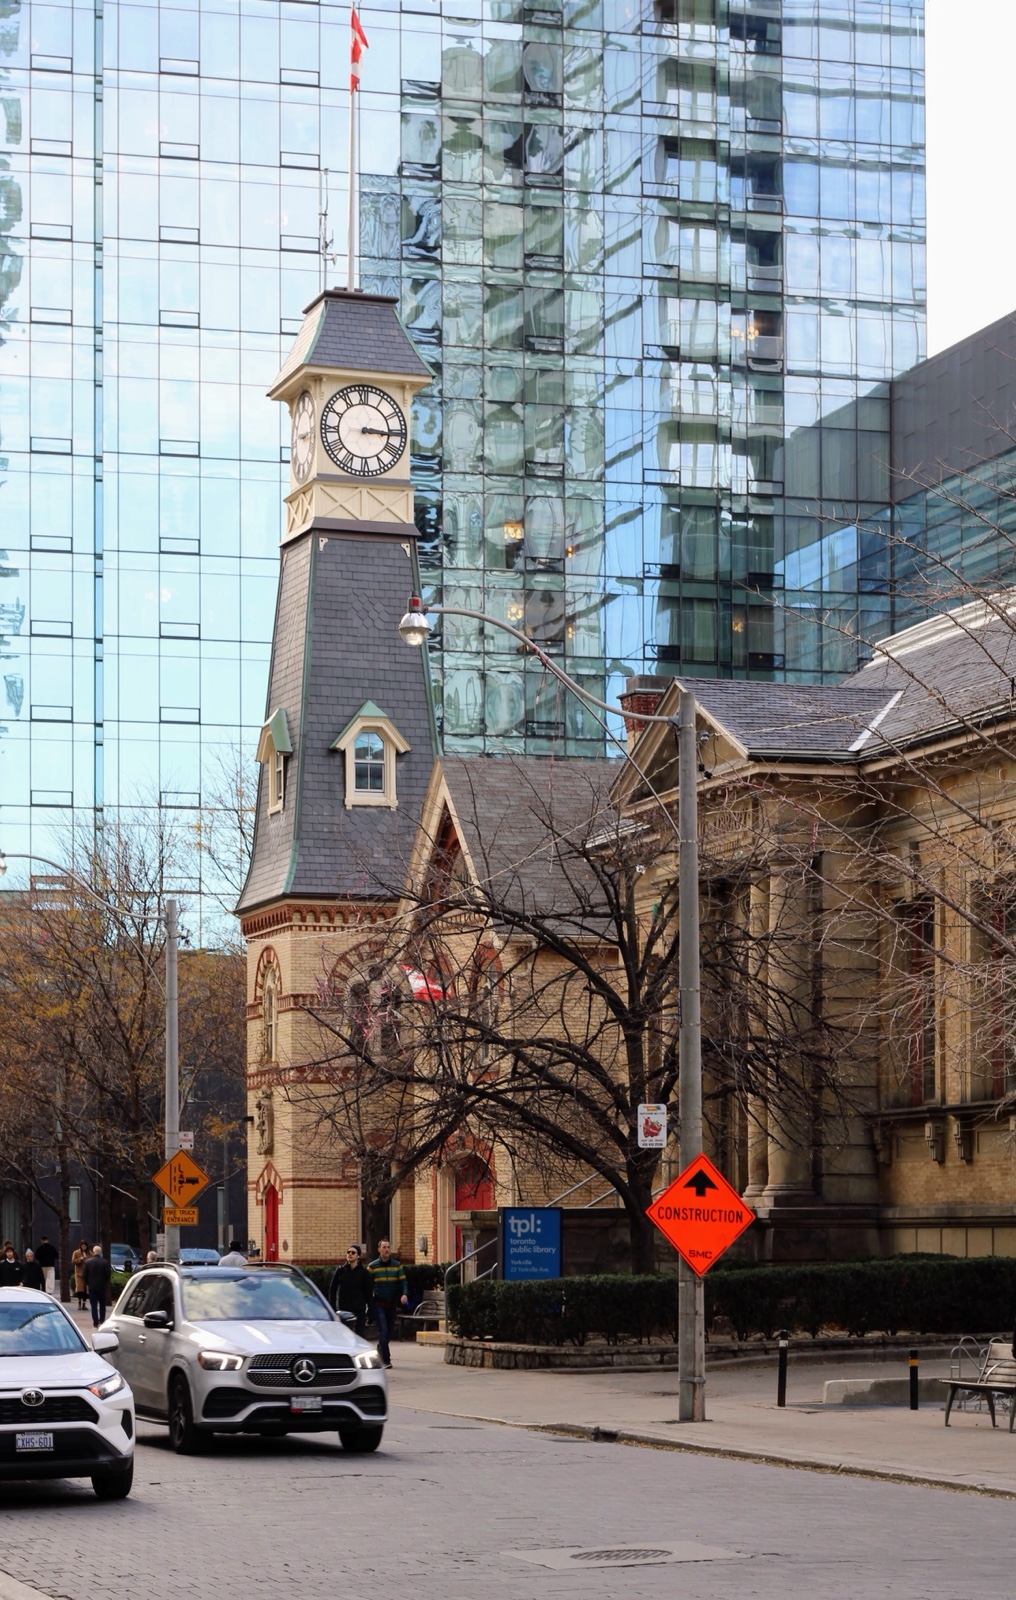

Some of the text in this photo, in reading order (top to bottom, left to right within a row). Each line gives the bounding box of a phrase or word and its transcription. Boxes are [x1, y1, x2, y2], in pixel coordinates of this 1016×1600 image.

[658, 1206, 743, 1223] CONSTRUCTION
[510, 1246, 556, 1255] public library
[689, 1250, 712, 1259] SMC
